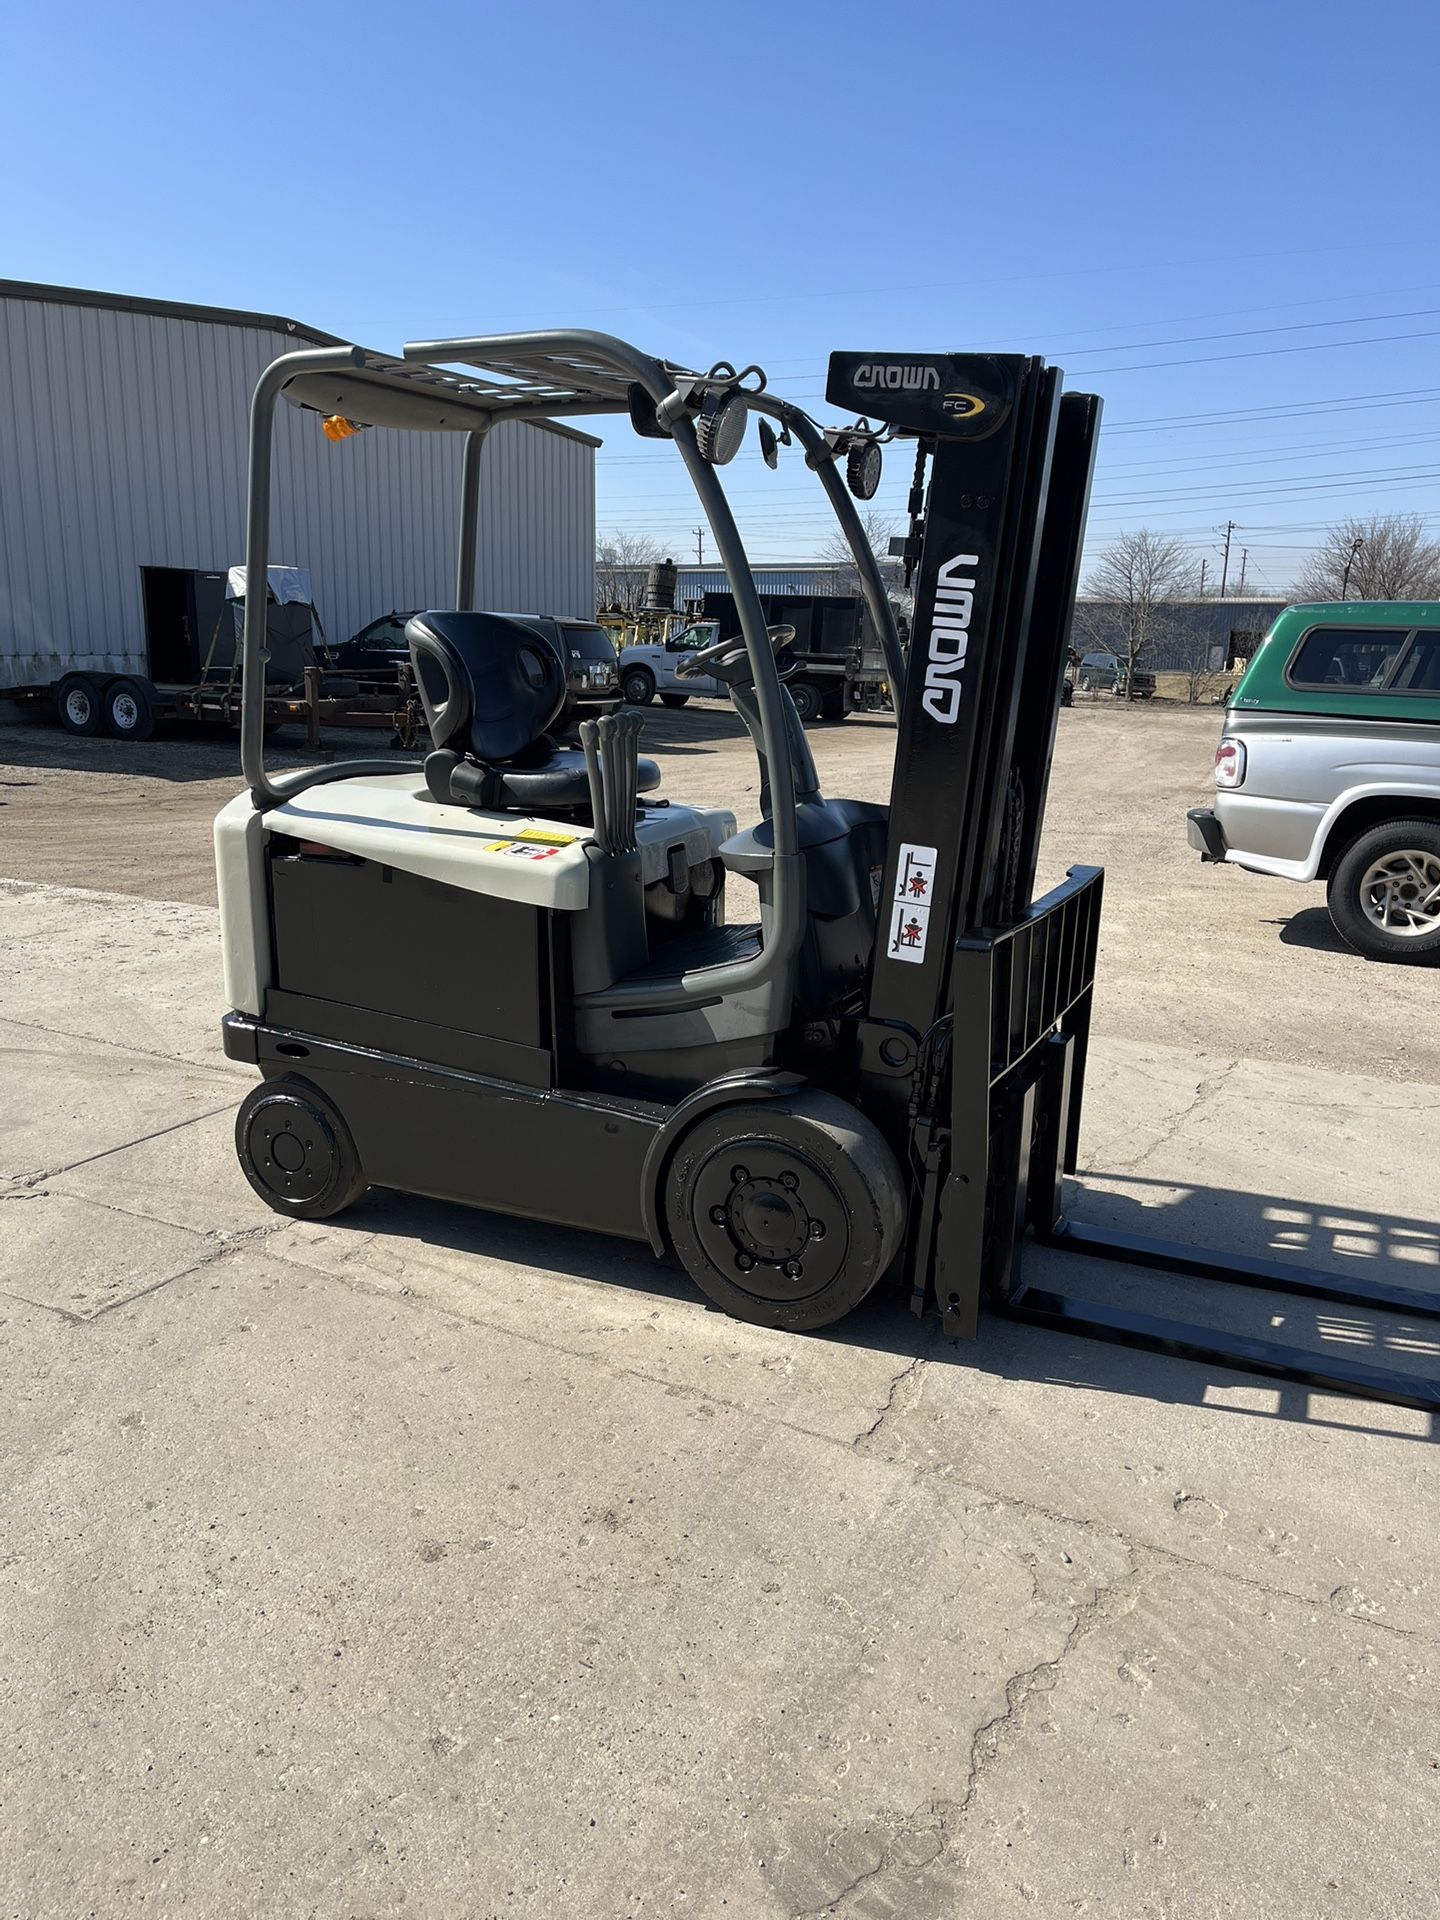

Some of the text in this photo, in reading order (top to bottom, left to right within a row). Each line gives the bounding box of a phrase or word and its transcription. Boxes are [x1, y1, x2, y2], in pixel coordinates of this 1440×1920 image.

[853, 364, 941, 390] CROWN
[942, 400, 967, 411] FC
[922, 554, 979, 724] CROWN
